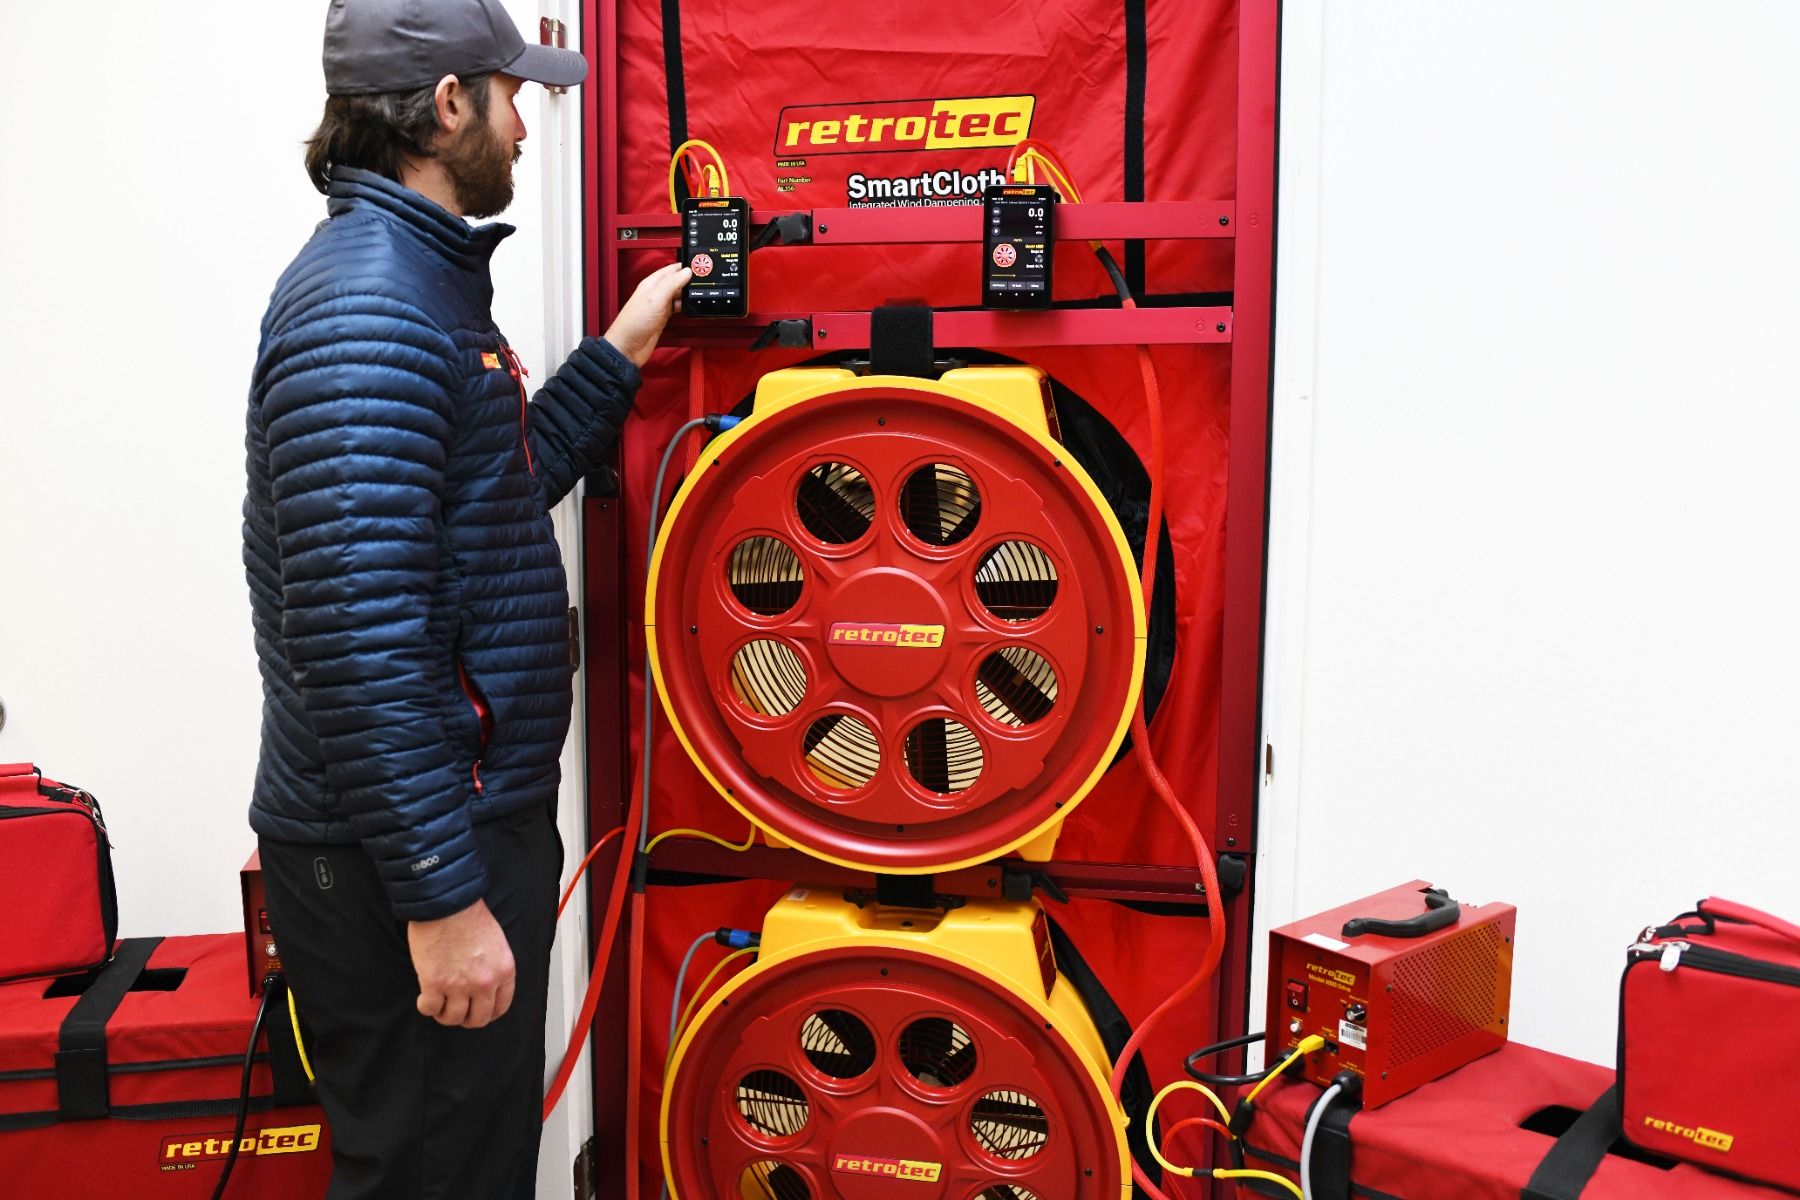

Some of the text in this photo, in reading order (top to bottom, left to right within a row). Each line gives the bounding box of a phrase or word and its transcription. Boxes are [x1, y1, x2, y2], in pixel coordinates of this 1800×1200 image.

[785, 110, 1021, 147] retrotec
[848, 170, 1006, 199] SmartCloth
[849, 199, 896, 208] Integrated
[897, 198, 922, 208] Wind
[924, 197, 980, 207] Dampening
[1028, 208, 1044, 217] 0.0
[723, 219, 738, 228] 0.0
[717, 232, 738, 241] 0.00
[833, 627, 939, 644] retrotec
[1306, 962, 1354, 985] retrotec
[1644, 1116, 1731, 1149] retrotec
[166, 1132, 314, 1158] retrotec
[836, 1158, 937, 1178] retrotec
